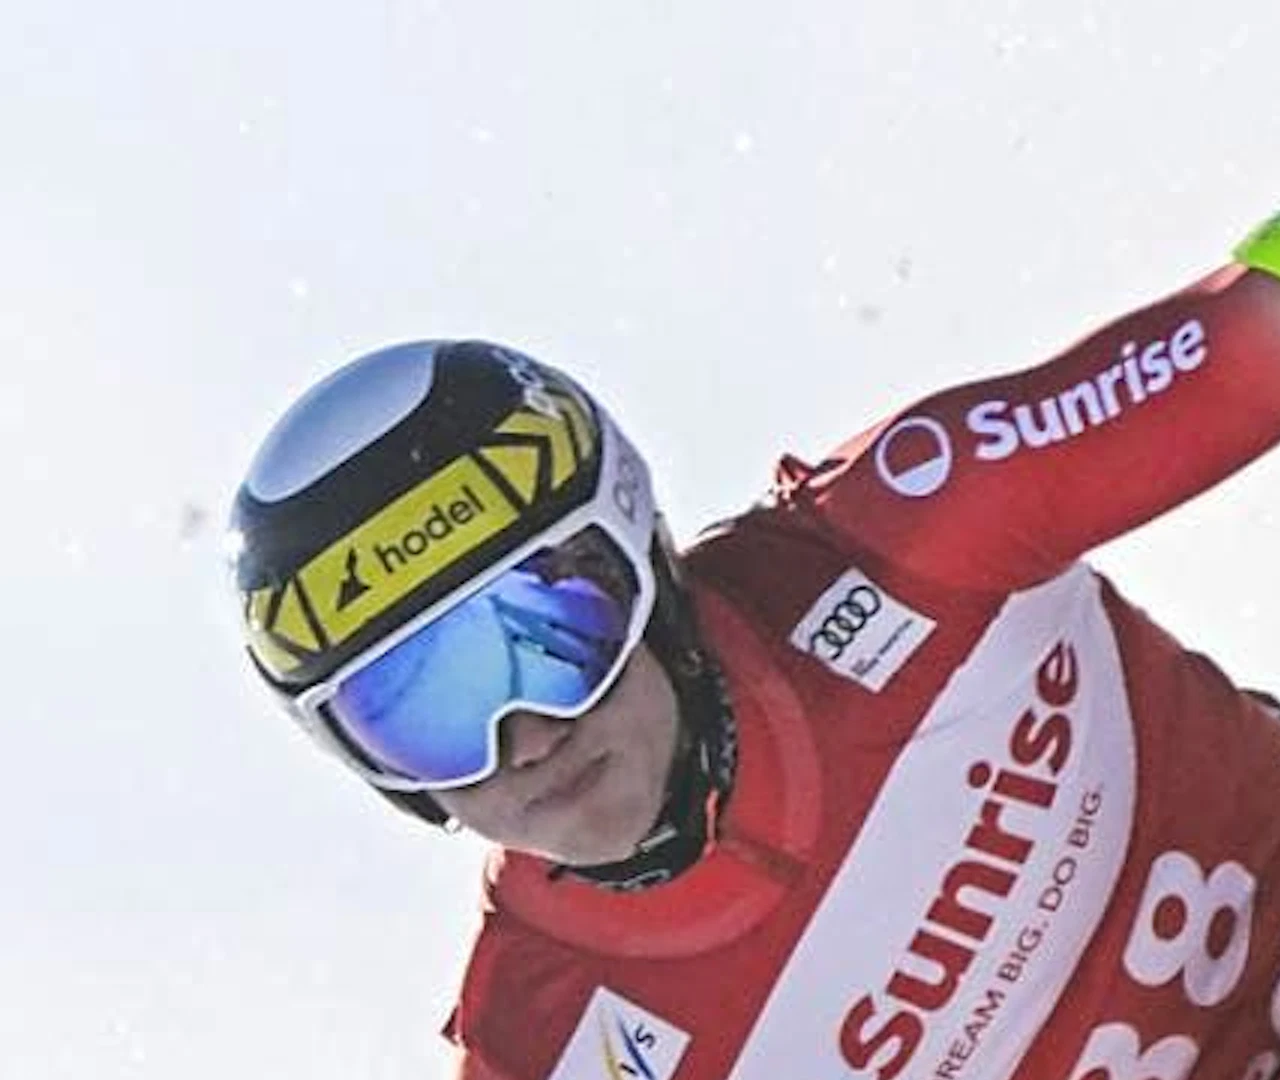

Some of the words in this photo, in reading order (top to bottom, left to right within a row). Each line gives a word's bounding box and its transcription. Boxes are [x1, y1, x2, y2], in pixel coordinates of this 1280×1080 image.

[966, 318, 1209, 461] Sunrise
[372, 484, 485, 573] hodel
[999, 920, 1049, 983] BIG.
[1037, 856, 1078, 913] DO
